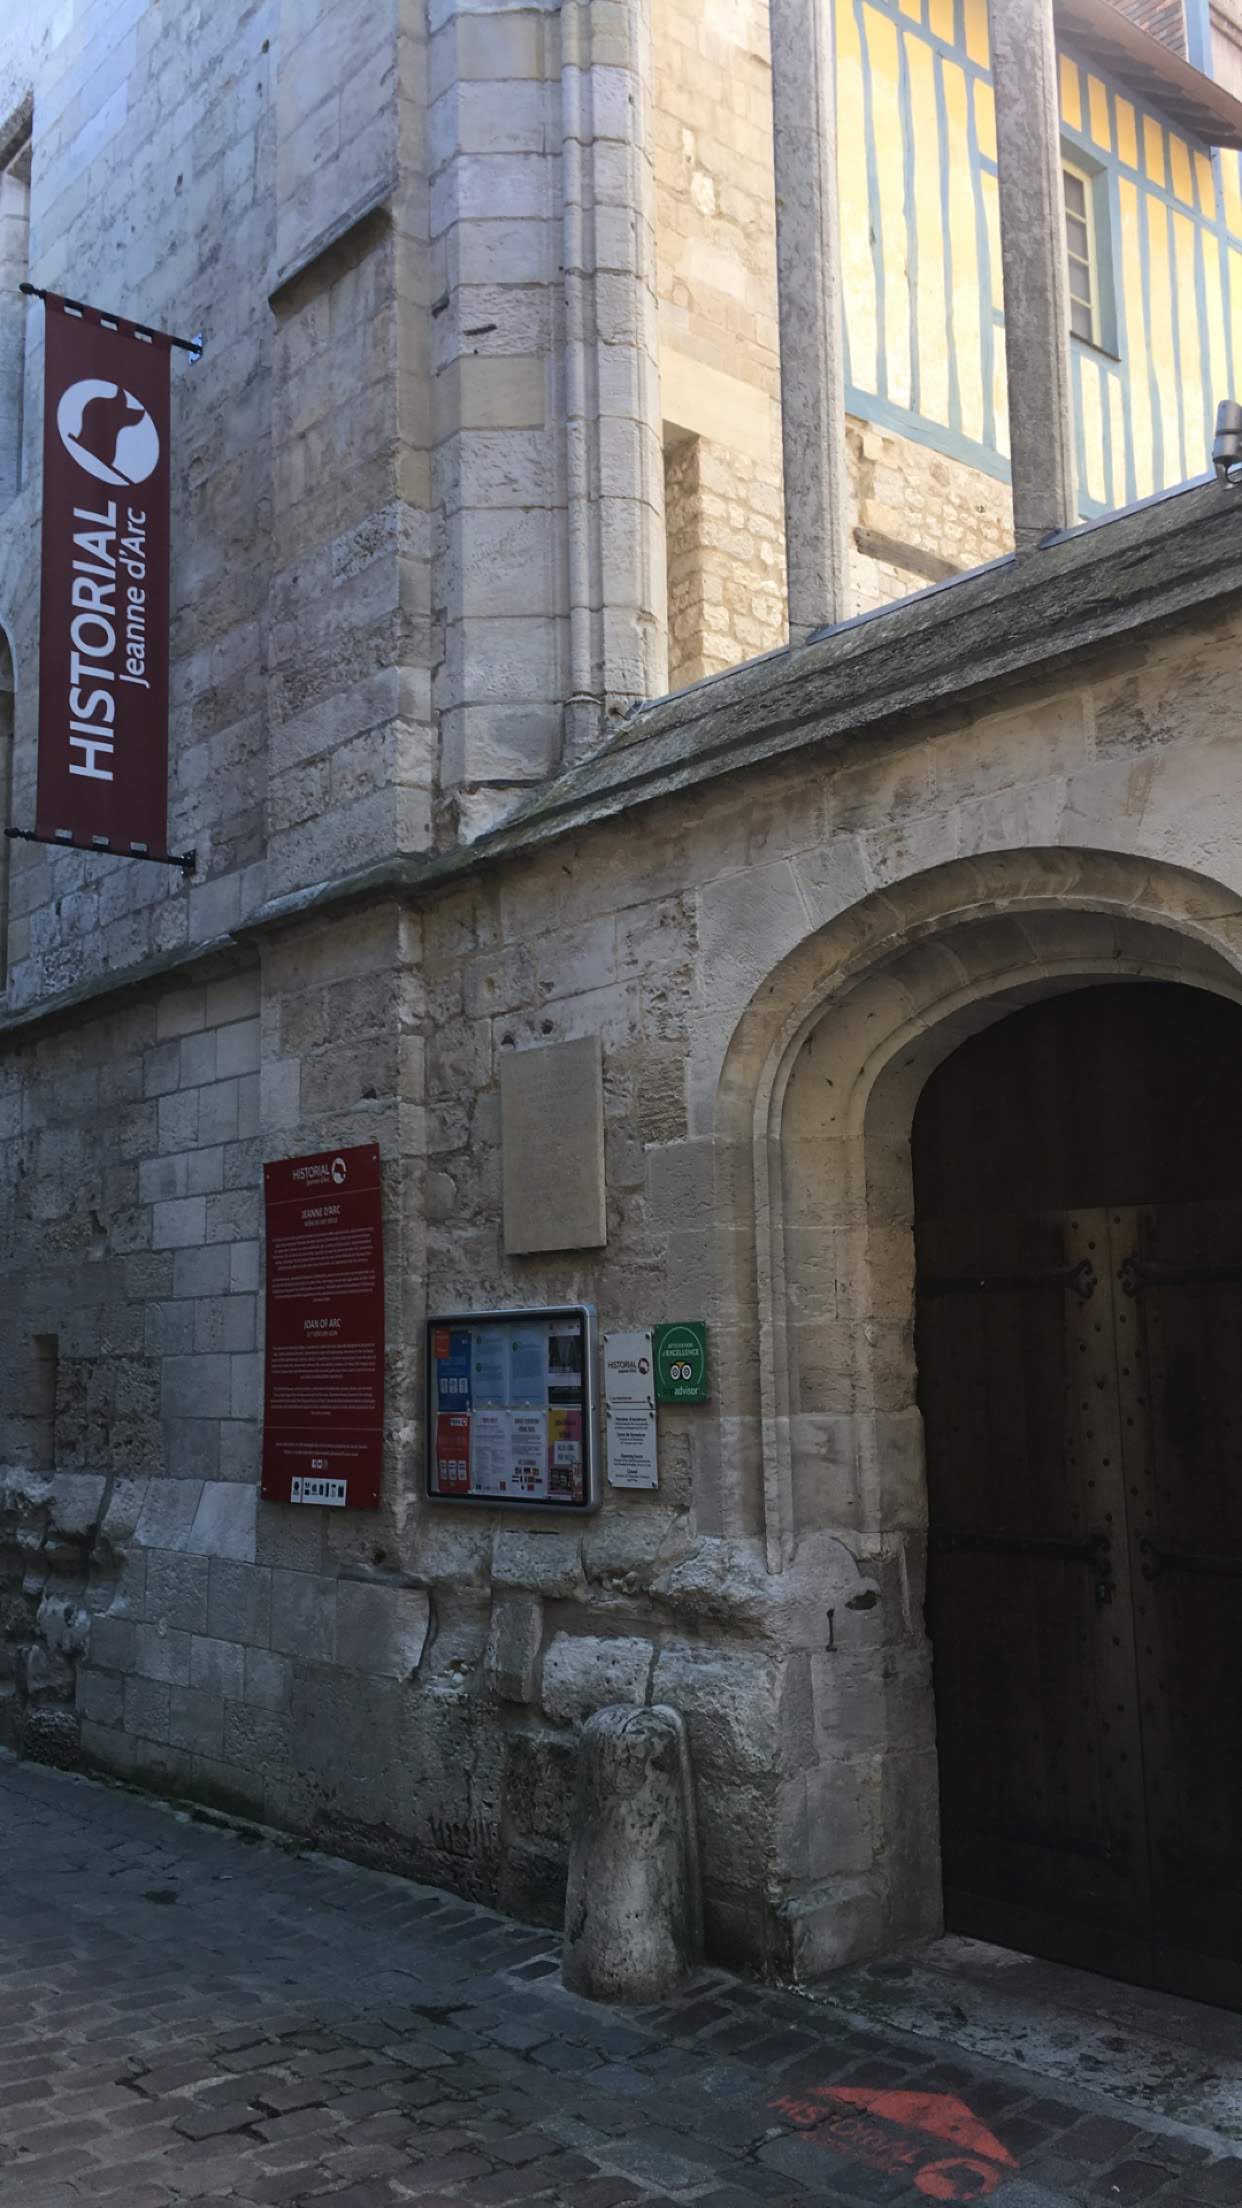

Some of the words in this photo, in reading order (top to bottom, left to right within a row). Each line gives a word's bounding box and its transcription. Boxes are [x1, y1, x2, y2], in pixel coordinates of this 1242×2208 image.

[118, 506, 147, 580] d'Arc
[68, 500, 118, 782] HISTORIAL
[119, 584, 151, 689] Jeanne
[292, 1165, 330, 1180] HISTORIAL
[301, 1208, 323, 1219] JEANNE
[323, 1205, 342, 1216] D'ARC
[303, 1319, 320, 1330] JOAN
[320, 1318, 329, 1329] OF
[328, 1317, 342, 1328] ARC
[607, 1360, 637, 1369] HISTORIAL
